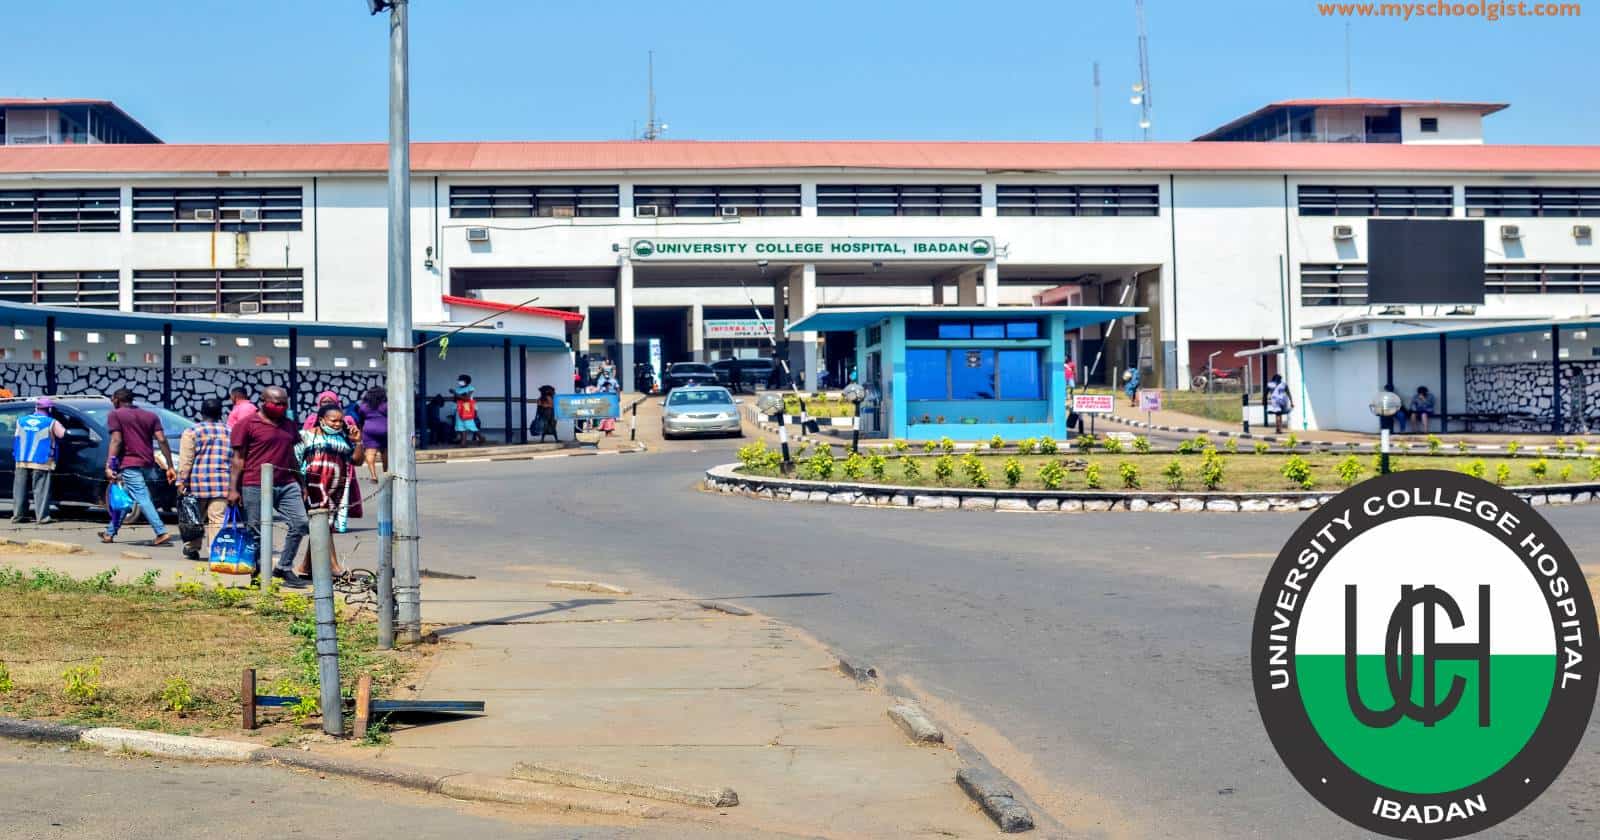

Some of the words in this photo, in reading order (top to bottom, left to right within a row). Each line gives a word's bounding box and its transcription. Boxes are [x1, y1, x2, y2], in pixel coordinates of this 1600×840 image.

[656, 242, 747, 255] UNIVERSITY
[755, 242, 825, 254] COLLEGE
[831, 241, 906, 256] HOSPITAL,
[914, 241, 969, 253] IBADAN
